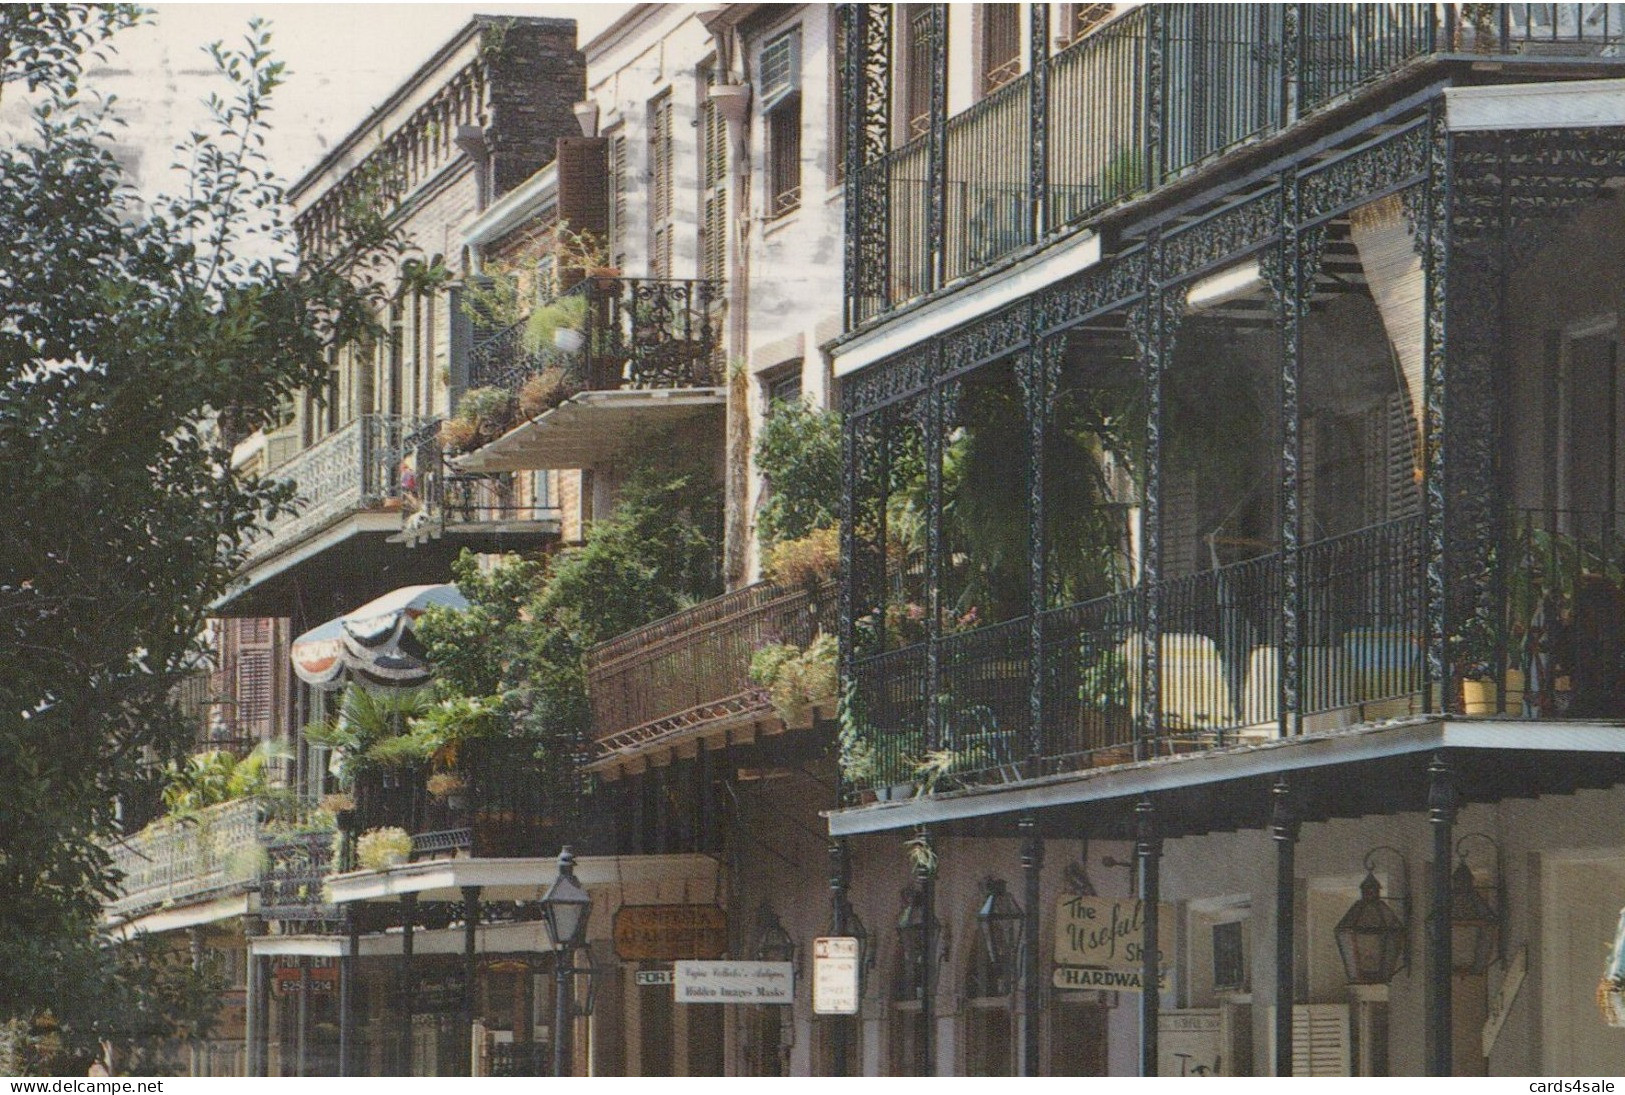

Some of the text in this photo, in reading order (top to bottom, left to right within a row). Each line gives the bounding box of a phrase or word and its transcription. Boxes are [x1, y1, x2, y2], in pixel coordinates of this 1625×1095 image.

[1062, 897, 1096, 919] The
[1066, 899, 1145, 959] Useful
[1126, 943, 1163, 962] Shp
[1066, 970, 1165, 989] HARDWAE
